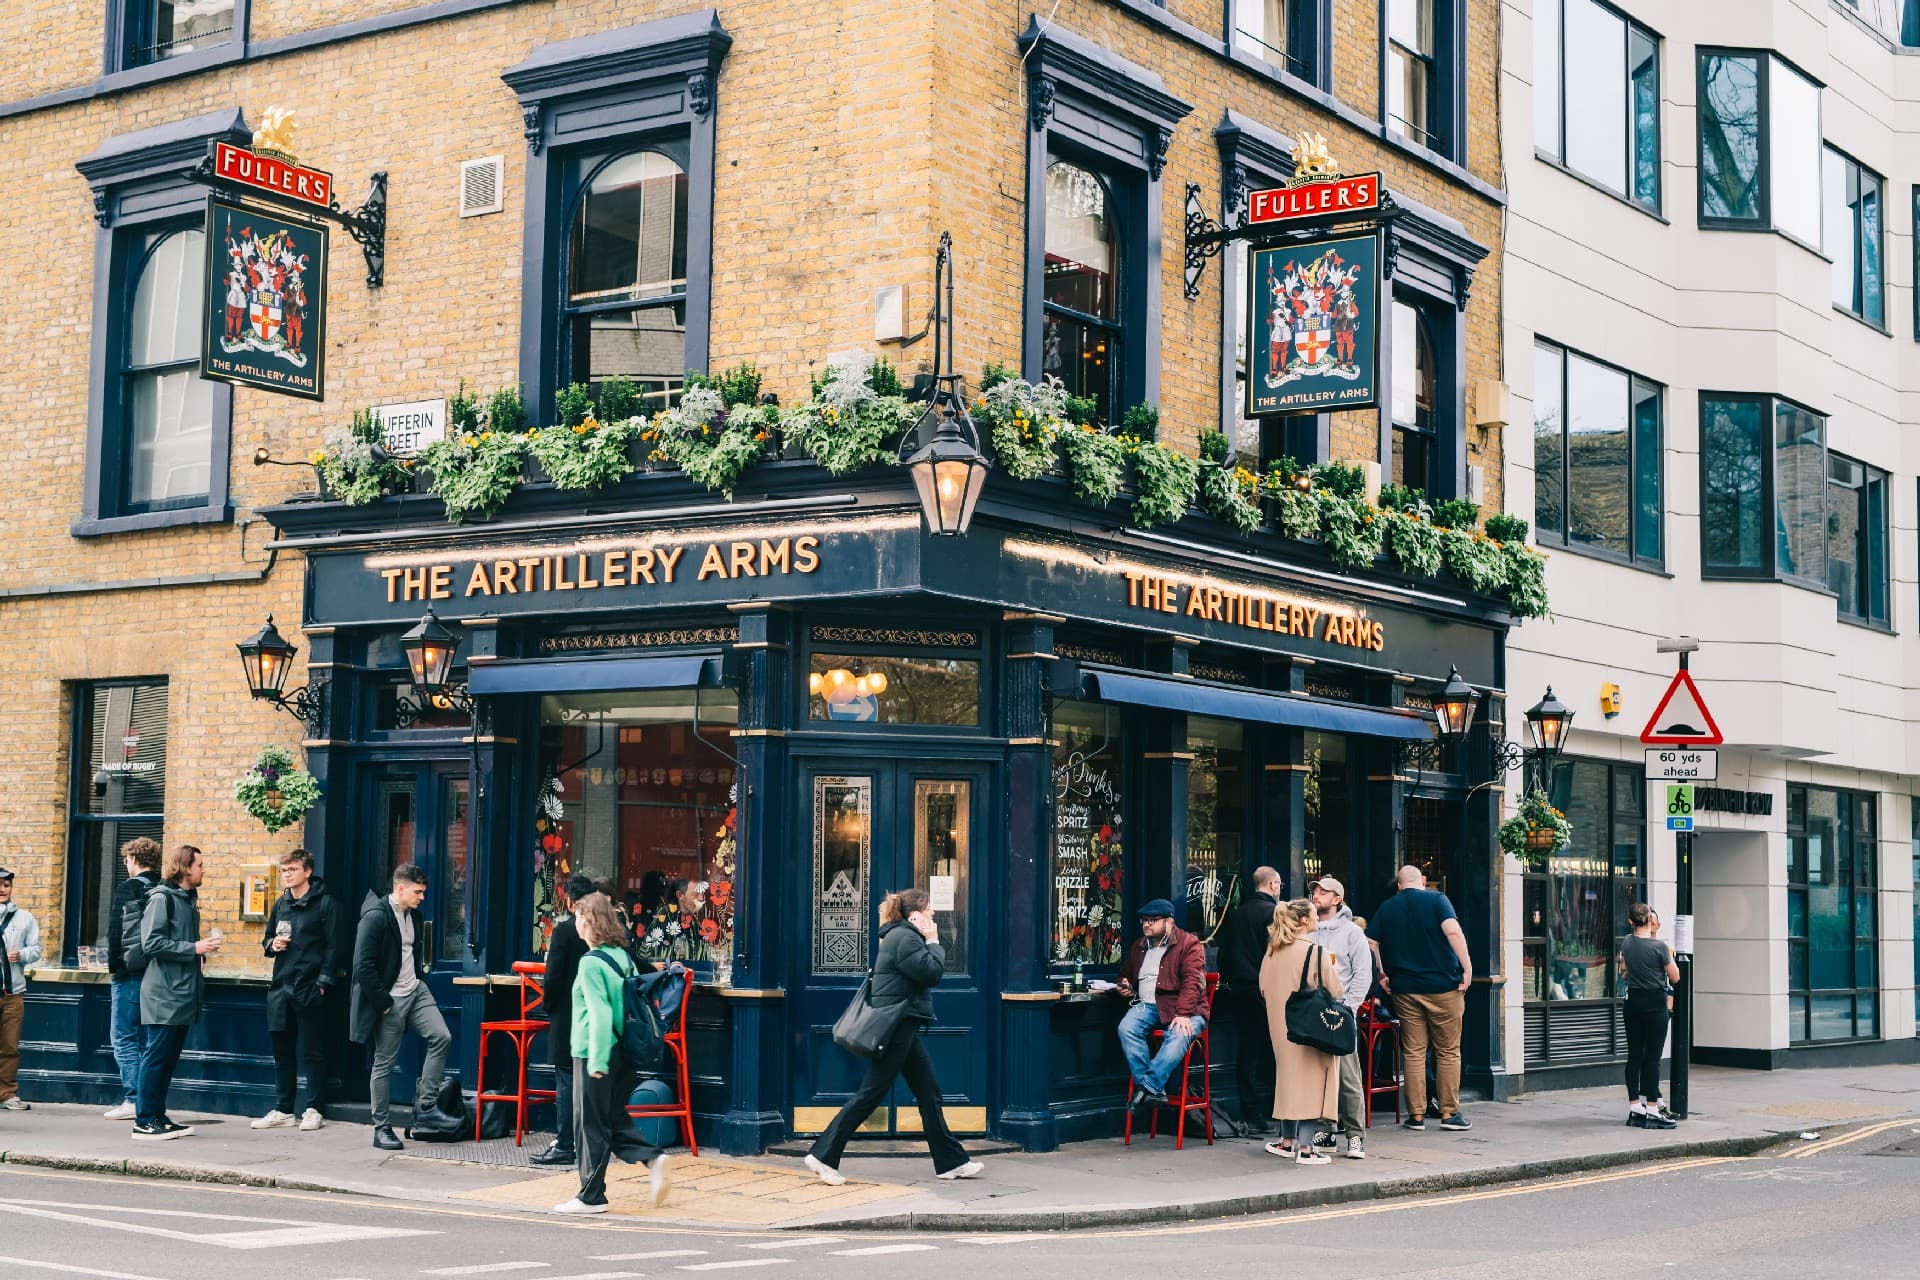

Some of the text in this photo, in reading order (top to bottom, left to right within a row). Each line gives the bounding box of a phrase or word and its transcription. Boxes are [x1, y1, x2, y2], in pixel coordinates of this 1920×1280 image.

[223, 148, 325, 199] FULLER'S
[1256, 183, 1369, 217] FULLER'S
[212, 358, 313, 388] THE ARTILLERY ARMS
[1257, 387, 1369, 407] THE ARTILLERY ARMS
[382, 432, 420, 450] TREET
[381, 536, 820, 602] THE ARTILLERY ARMS
[1124, 571, 1384, 652] THE ARTILLERY ARMS
[102, 762, 121, 771] MADE
[132, 761, 157, 770] RUGBY
[1660, 752, 1702, 765] 60 yds
[1663, 766, 1698, 777] ahead
[1746, 792, 1773, 815] ROW
[1057, 815, 1088, 828] SPRITZ
[1058, 846, 1088, 859] SMASH
[1055, 876, 1090, 889] DRIZZLE
[1057, 905, 1088, 918] SPRITZ
